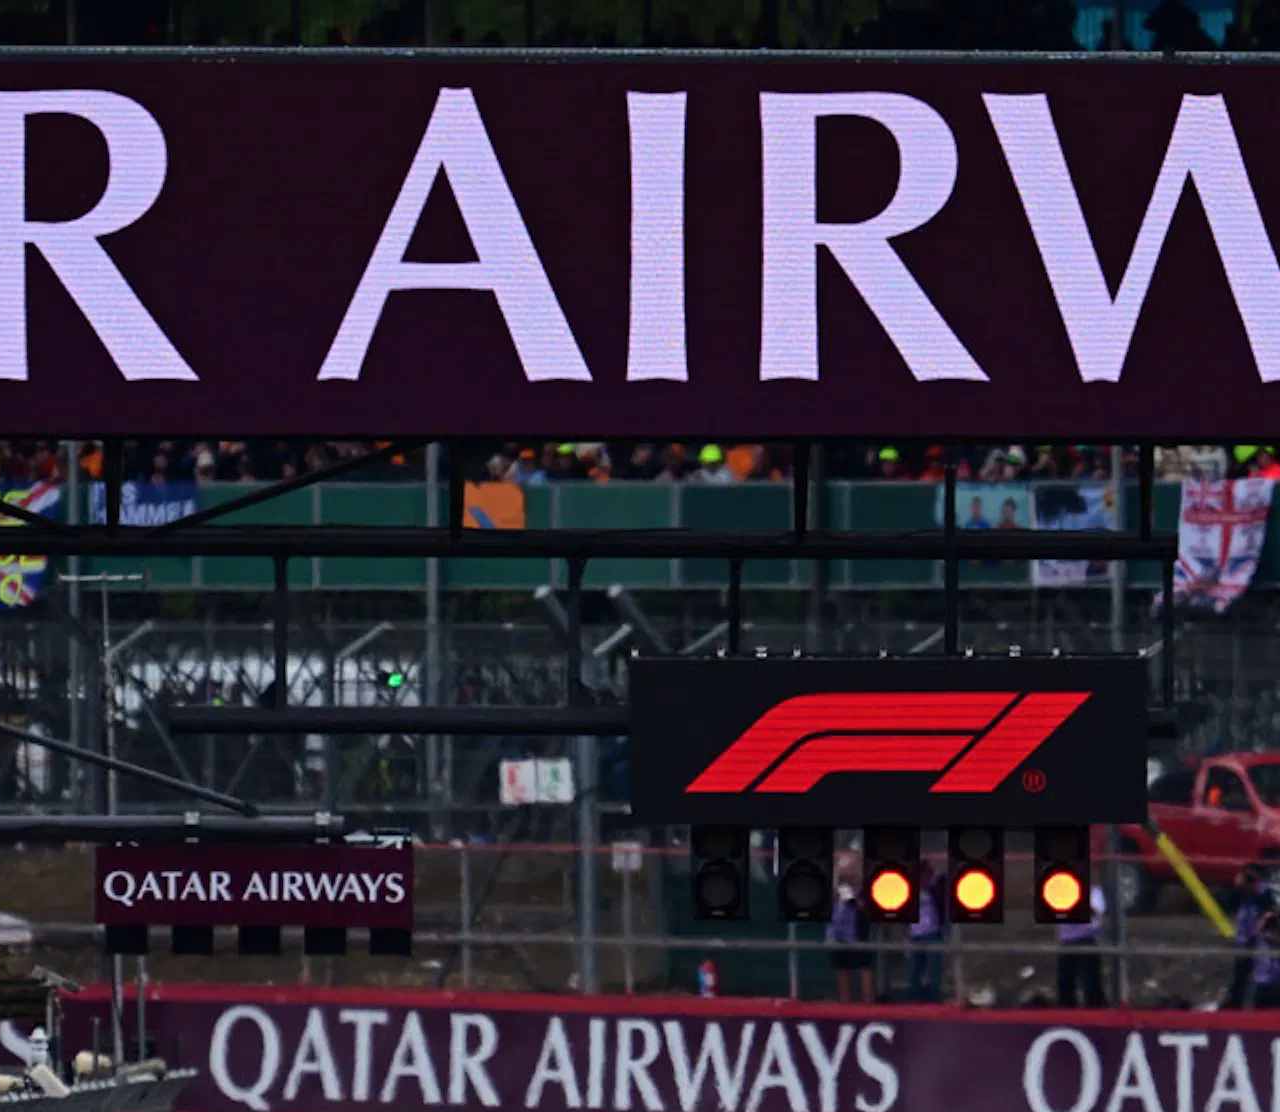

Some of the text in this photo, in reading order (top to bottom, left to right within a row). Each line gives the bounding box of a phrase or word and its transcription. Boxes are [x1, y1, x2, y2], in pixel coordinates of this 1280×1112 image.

[684, 691, 1094, 794] F1
[103, 870, 406, 906] QATAR AIRWAYS
[208, 1004, 502, 1112] QATAR
